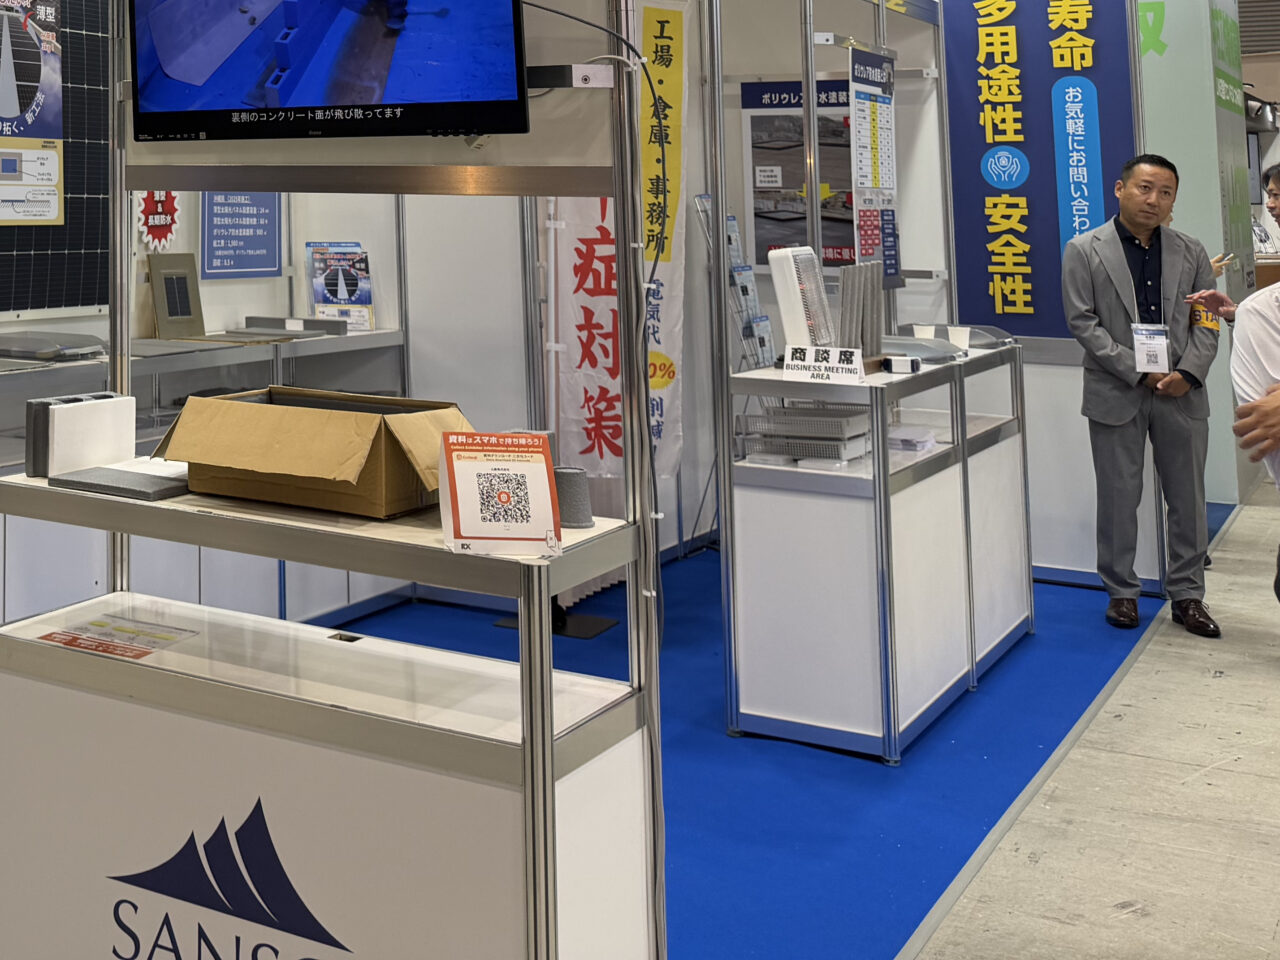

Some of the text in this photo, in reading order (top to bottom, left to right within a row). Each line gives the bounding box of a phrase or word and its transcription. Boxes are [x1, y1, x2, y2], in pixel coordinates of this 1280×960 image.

[36, 5, 56, 23] 薄型
[231, 107, 404, 124] 裏側のコンクリート面が飛び散ってます
[644, 19, 674, 255] 工場・倉庫・事務所
[1064, 86, 1091, 238] お気軽にお問い合わ
[147, 214, 172, 226] 長期防水
[983, 193, 1035, 316] 安全性
[572, 197, 624, 461] 症対策
[790, 347, 855, 365] 商談席
[785, 363, 858, 375] BUSINESS MEETING
